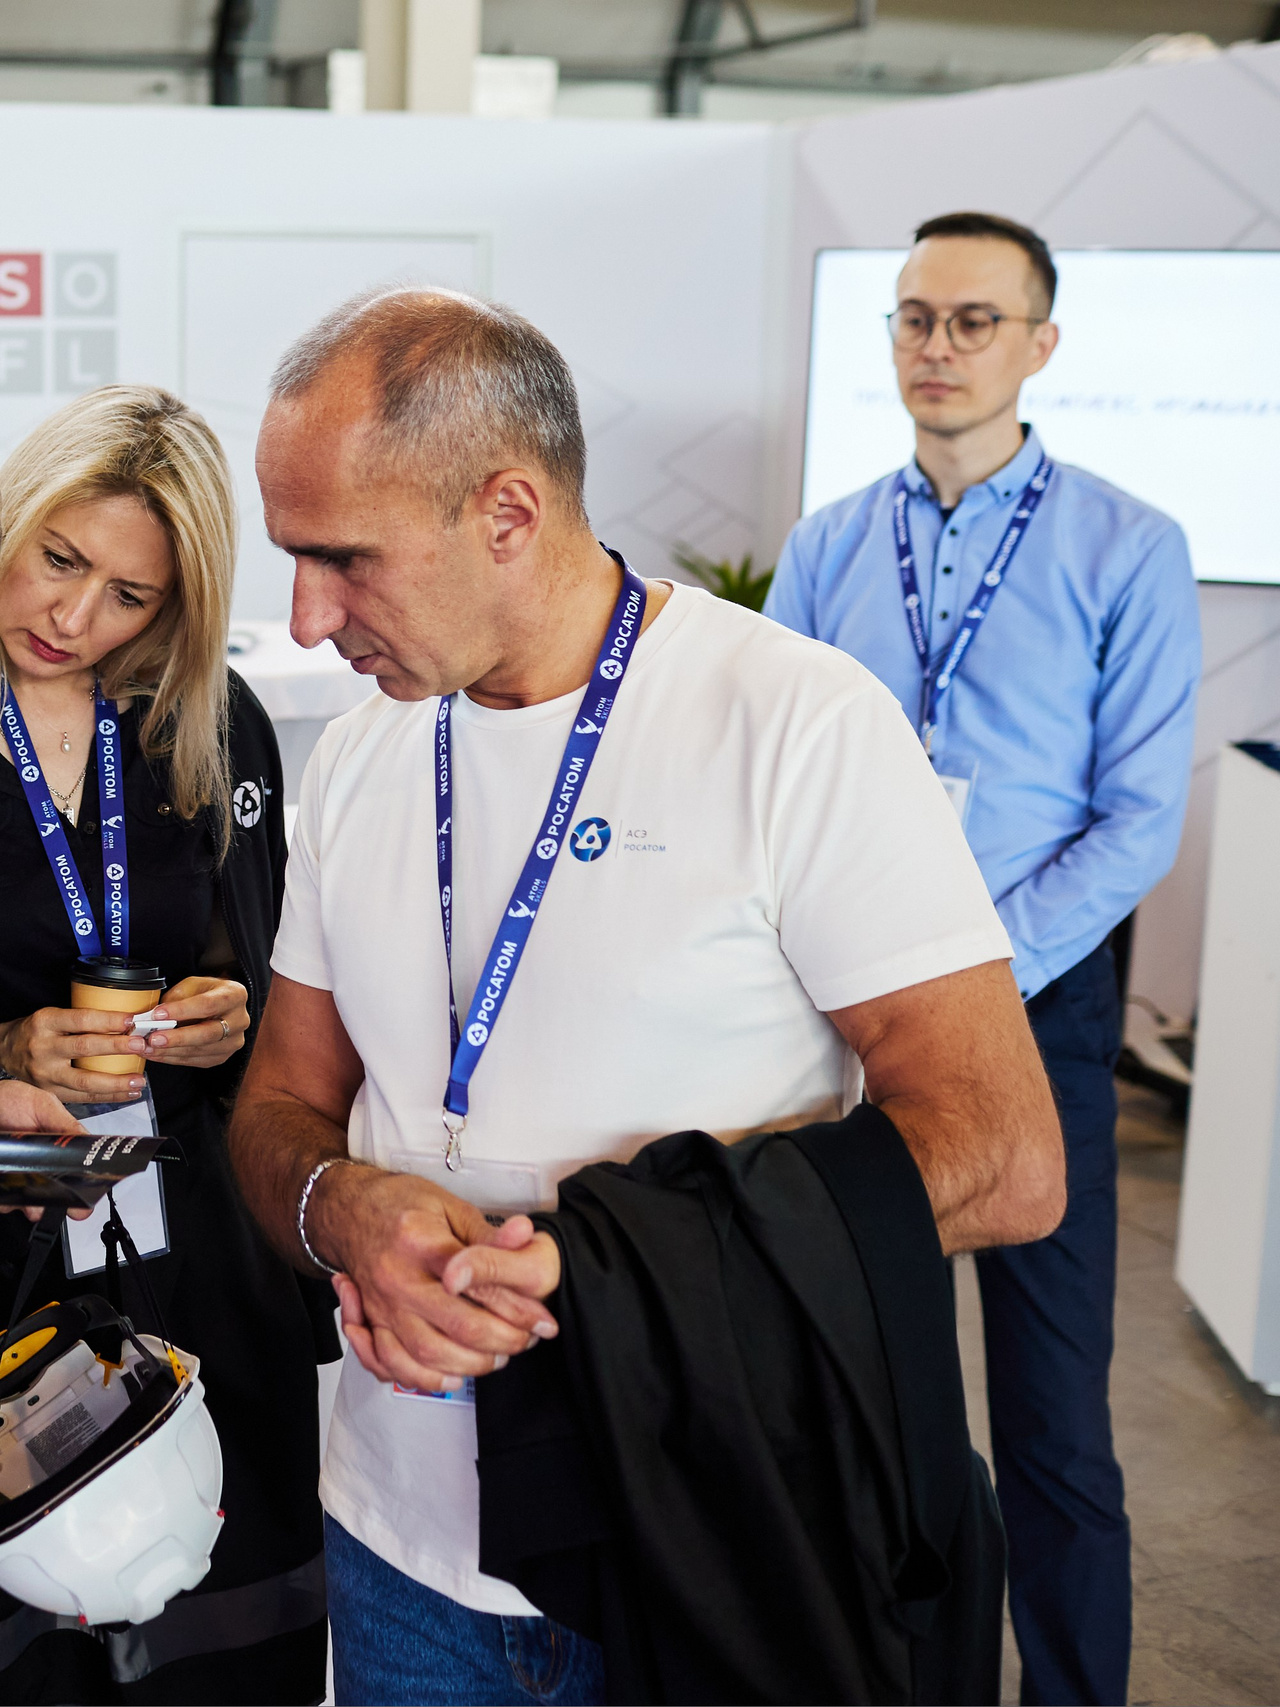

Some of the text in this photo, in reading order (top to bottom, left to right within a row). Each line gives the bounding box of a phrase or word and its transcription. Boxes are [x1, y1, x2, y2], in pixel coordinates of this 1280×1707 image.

[610, 590, 641, 658] РОСАТОМ
[3, 704, 31, 764] РОСАТОМ
[594, 697, 607, 718] ATOM
[601, 699, 613, 720] SKILLS
[103, 737, 117, 799] РОСАТОМ
[439, 722, 448, 796] РОСАТОМ
[40, 801, 52, 818] ATOM
[547, 757, 586, 836] РОСАТОМ
[623, 843, 667, 852] РОСАТОМ
[626, 829, 648, 839] АСЭ
[55, 854, 86, 918] РОСАТОМ
[110, 882, 122, 946] РОСАТОМ
[528, 878, 541, 901] ATOM
[534, 880, 547, 902] SKILLS
[477, 940, 518, 1022] РОСАТОМ
